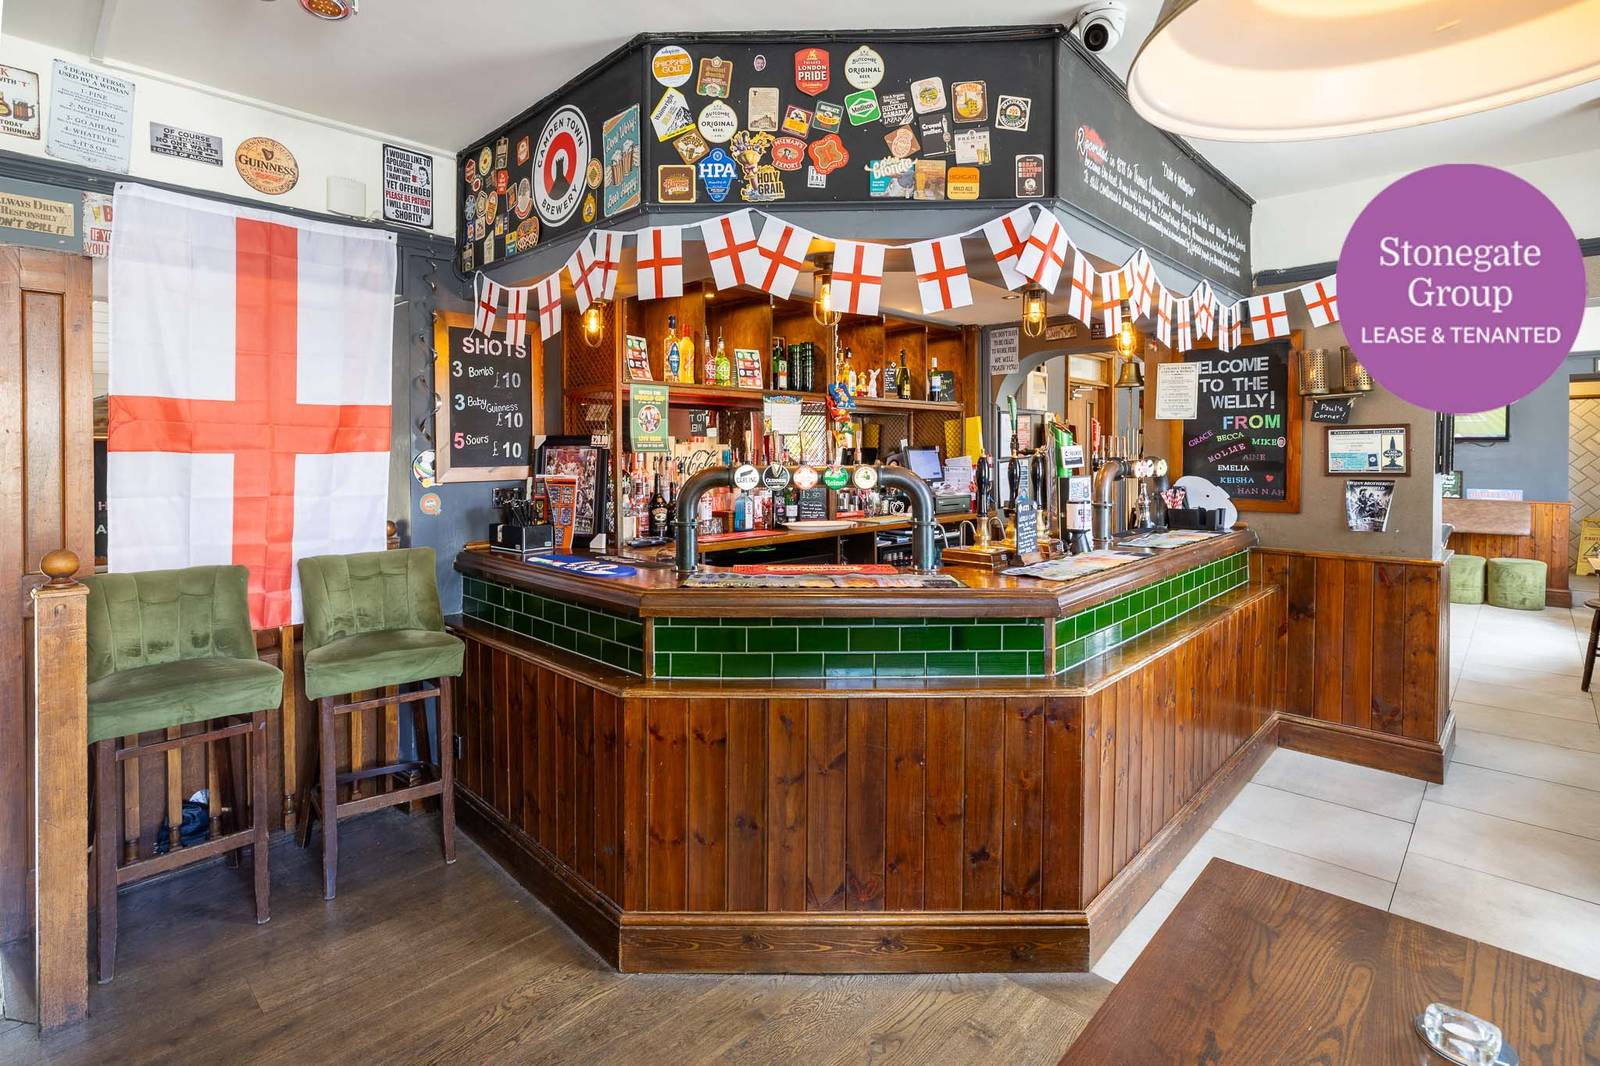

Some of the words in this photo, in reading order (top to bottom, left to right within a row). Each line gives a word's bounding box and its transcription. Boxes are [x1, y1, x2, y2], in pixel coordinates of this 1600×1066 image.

[662, 64, 684, 73] GOLD
[798, 72, 827, 80] PRIDE
[58, 70, 79, 80] USED
[100, 82, 129, 96] WOMAN
[70, 67, 98, 80] DEADLY
[102, 78, 126, 88] TERMS
[90, 90, 108, 100] FINE
[78, 104, 116, 120] NOTHING
[75, 116, 87, 125] GO
[89, 122, 117, 133] AHEAD
[922, 121, 942, 129] Crowd
[73, 128, 117, 144] WHATEVER
[178, 131, 210, 142] COURSE
[537, 119, 564, 168] CAMDEN
[566, 117, 584, 148] TOWN
[238, 154, 296, 176] GUINNESS
[386, 157, 413, 170] APOLOGIZE
[390, 150, 410, 162] WOULD
[411, 156, 422, 165] LIKE
[423, 159, 430, 168] TO
[699, 163, 737, 178] HPA
[757, 171, 778, 183] HOLY
[386, 180, 398, 190] YET
[399, 183, 430, 198] OFFENDED
[758, 183, 784, 195] GRAIL
[386, 190, 403, 202] PLEASE
[412, 196, 431, 207] PATIENT
[390, 200, 401, 209] WILL
[541, 183, 578, 215] BREWERY
[0, 216, 23, 227] ON'T
[26, 221, 52, 232] SPILL
[56, 226, 66, 234] IT
[462, 336, 527, 359] SHOTS
[452, 360, 463, 377] 3
[468, 366, 494, 378] Bombs
[1199, 356, 1269, 375] ELCOME
[1200, 378, 1224, 393] TO
[1232, 376, 1268, 391] THE
[455, 394, 465, 410] 3
[468, 396, 486, 409] Baby
[486, 403, 518, 413] Guinness
[1211, 390, 1275, 409] WELLY!
[1320, 403, 1344, 412] Paul's
[496, 412, 524, 428] £10
[1223, 414, 1280, 430] FROM
[1314, 411, 1346, 420] Corner!
[454, 432, 465, 449] 5
[466, 434, 489, 445] Sours
[1188, 430, 1214, 447] GRACE
[1216, 432, 1244, 442] BECCA
[1208, 443, 1246, 463] MOLLIE
